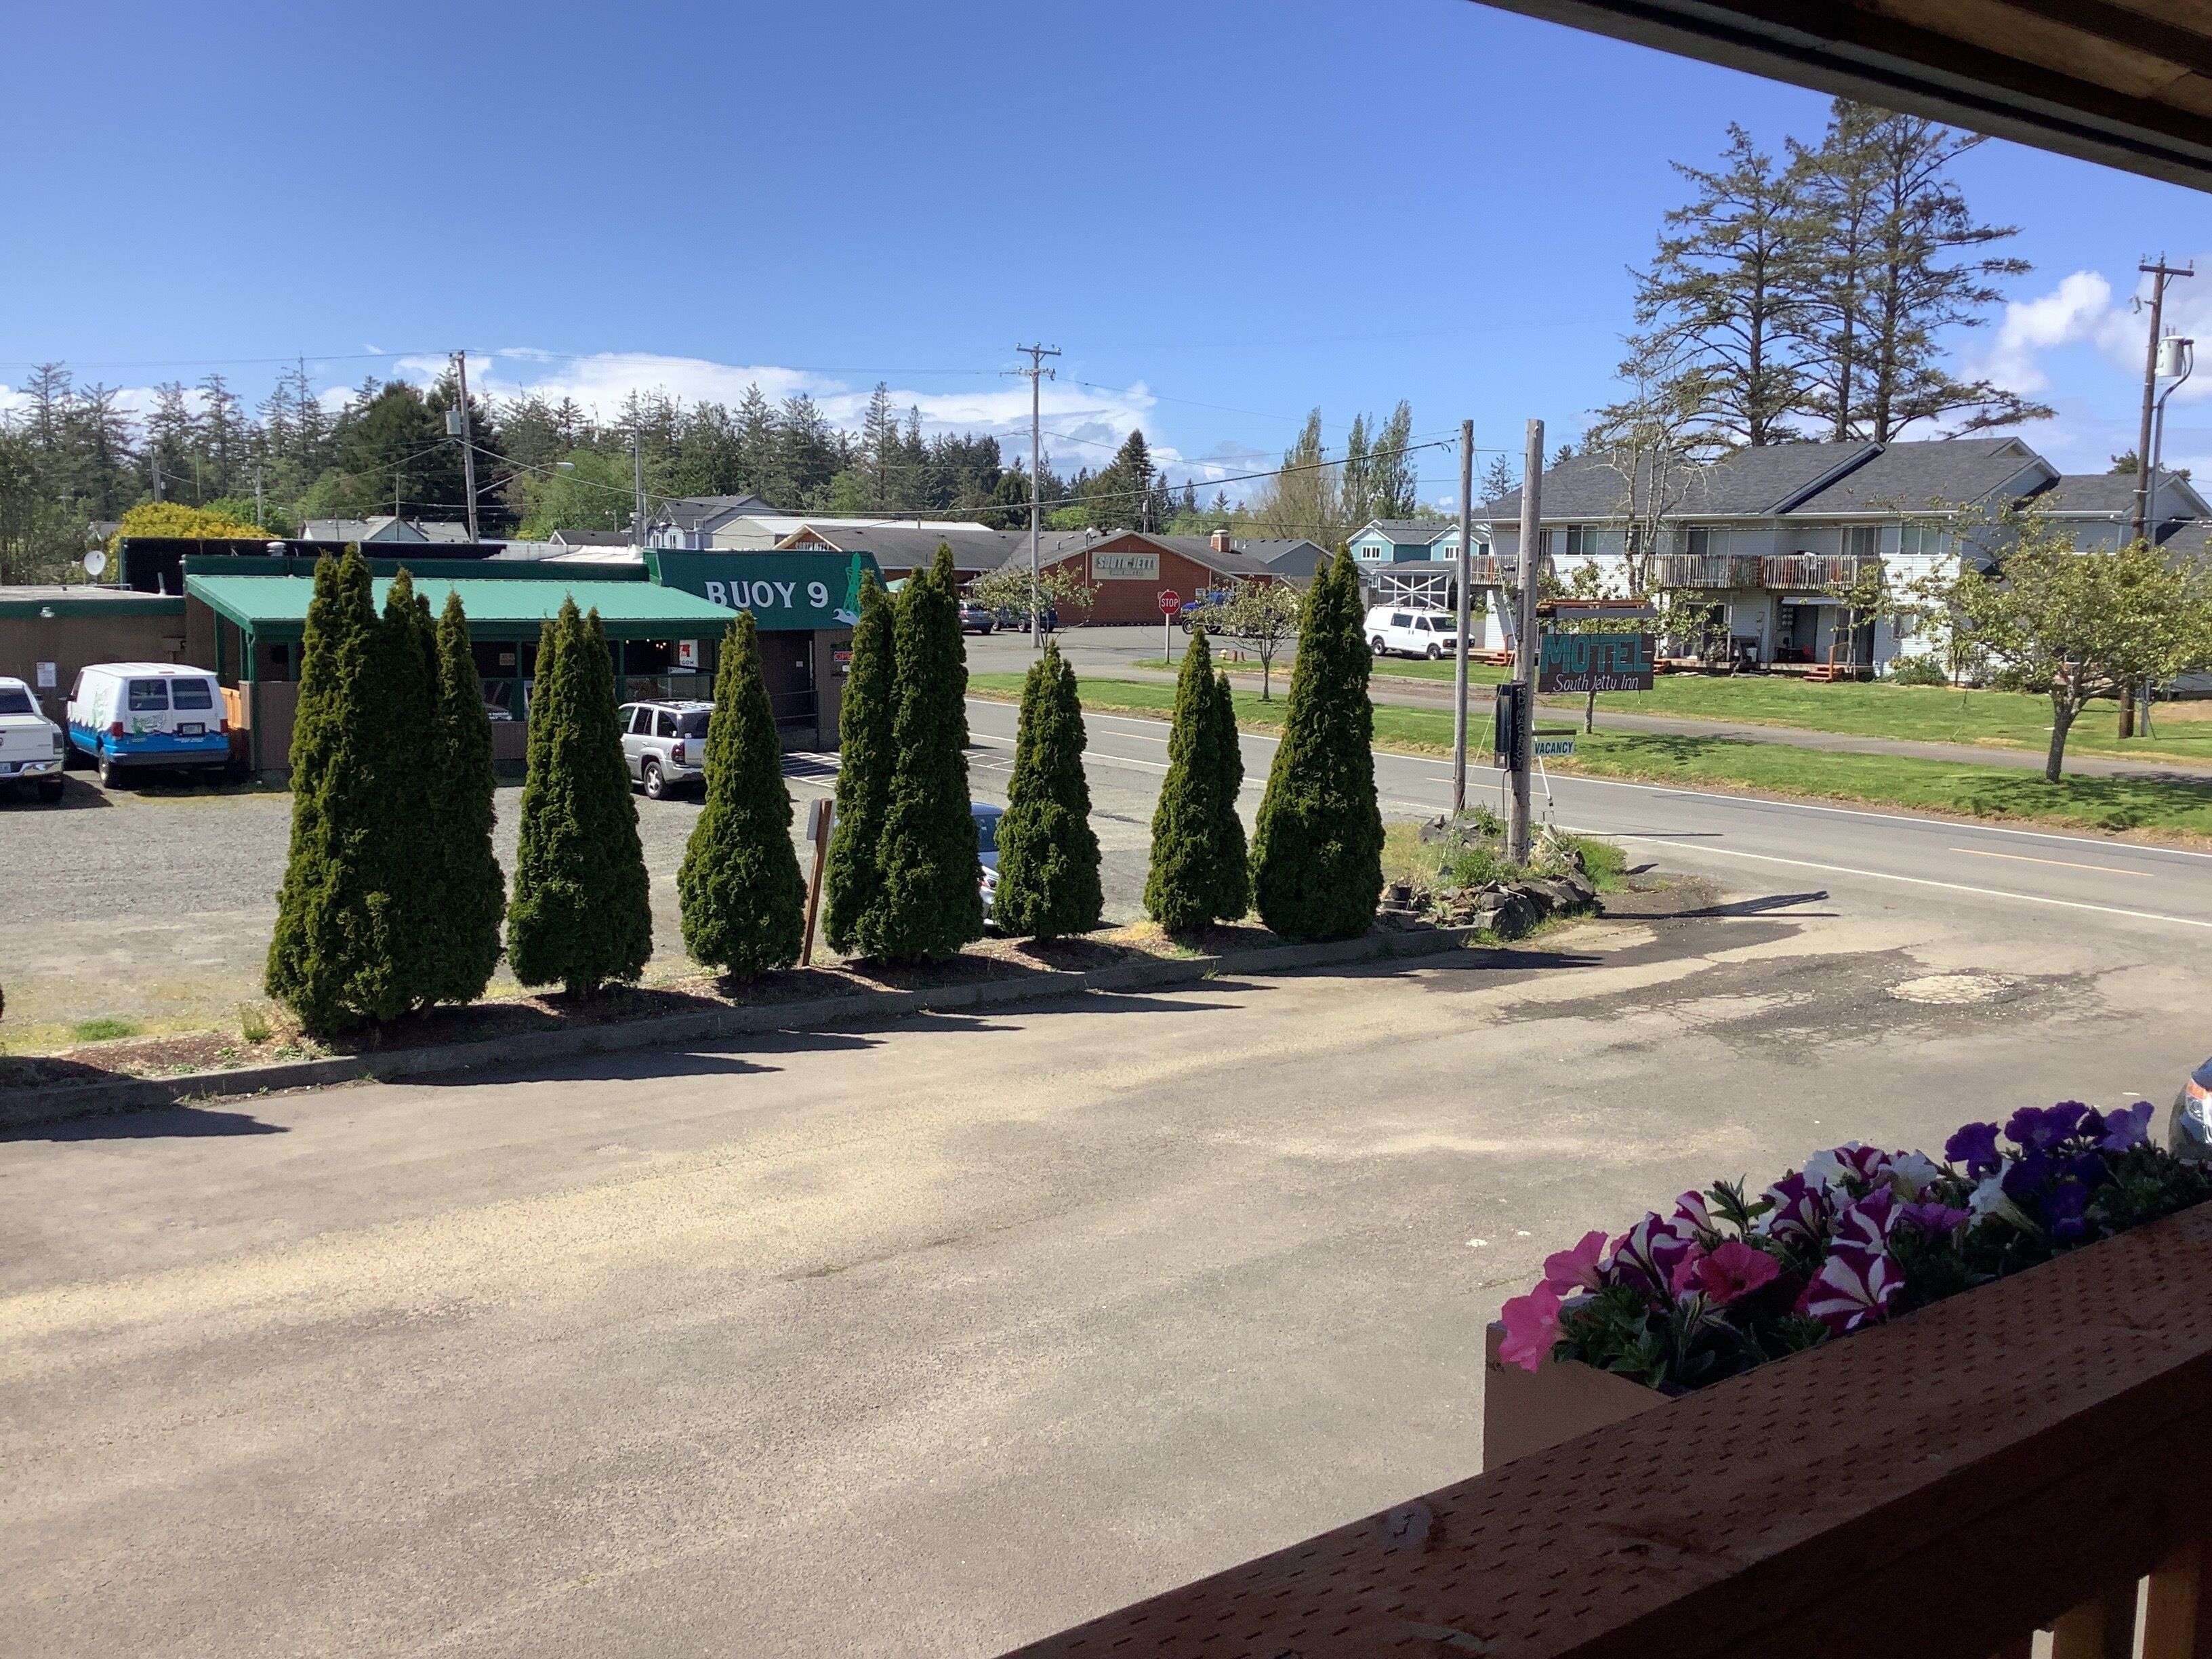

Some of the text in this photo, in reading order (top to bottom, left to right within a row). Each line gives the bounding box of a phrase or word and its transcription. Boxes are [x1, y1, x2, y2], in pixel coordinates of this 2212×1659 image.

[705, 580, 829, 609] BUOY 9
[1161, 598, 1179, 607] STOP
[1540, 634, 1652, 674] MOTEL
[1553, 674, 1639, 691] South Jetty Inn
[1534, 741, 1574, 754] VACANCY
